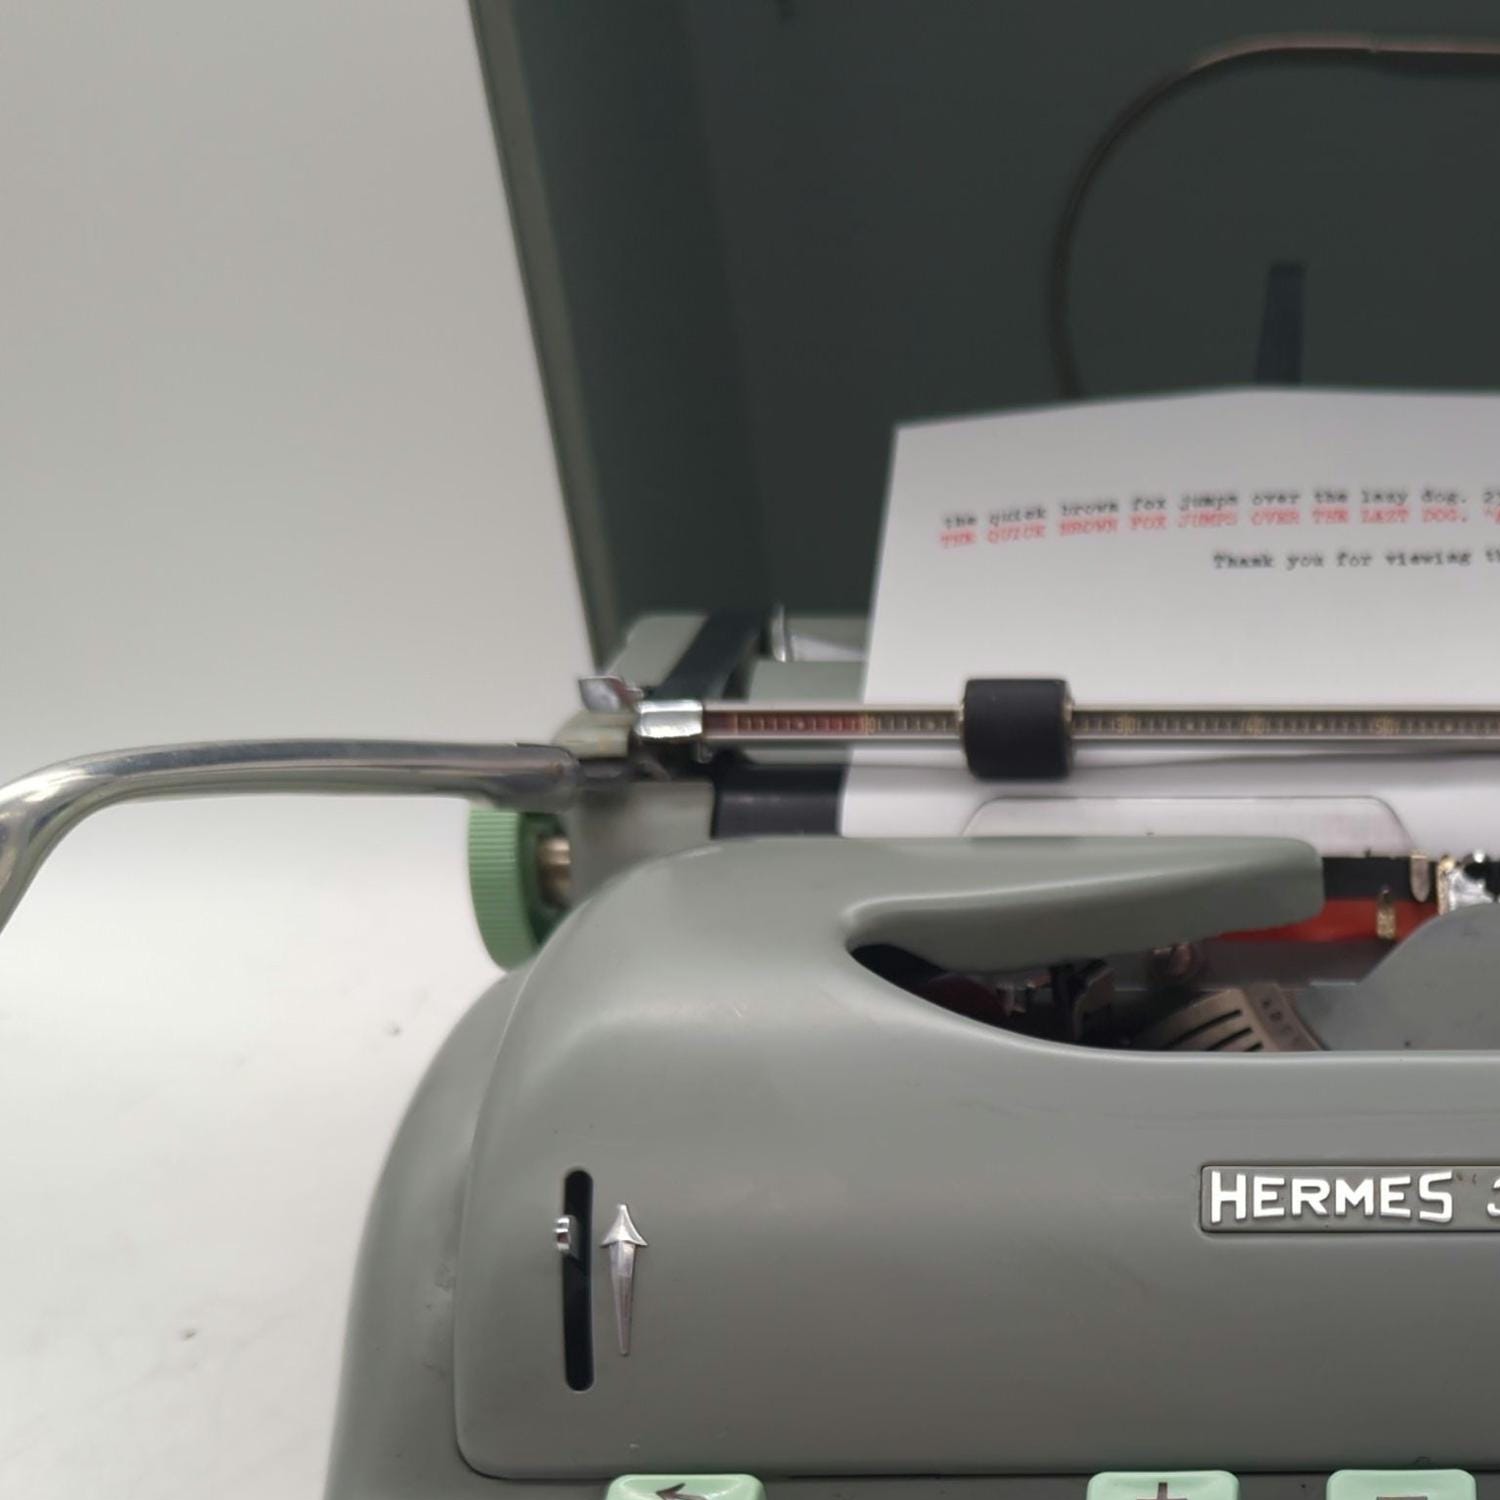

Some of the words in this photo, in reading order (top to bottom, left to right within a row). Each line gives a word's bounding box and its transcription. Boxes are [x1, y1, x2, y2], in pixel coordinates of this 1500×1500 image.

[1252, 493, 1301, 506] over
[1314, 490, 1348, 504] the
[1213, 552, 1273, 569] Thank
[1286, 553, 1324, 571] you
[1336, 551, 1372, 567] for
[1385, 552, 1471, 567] viewing
[1210, 1170, 1454, 1225] HERMES
